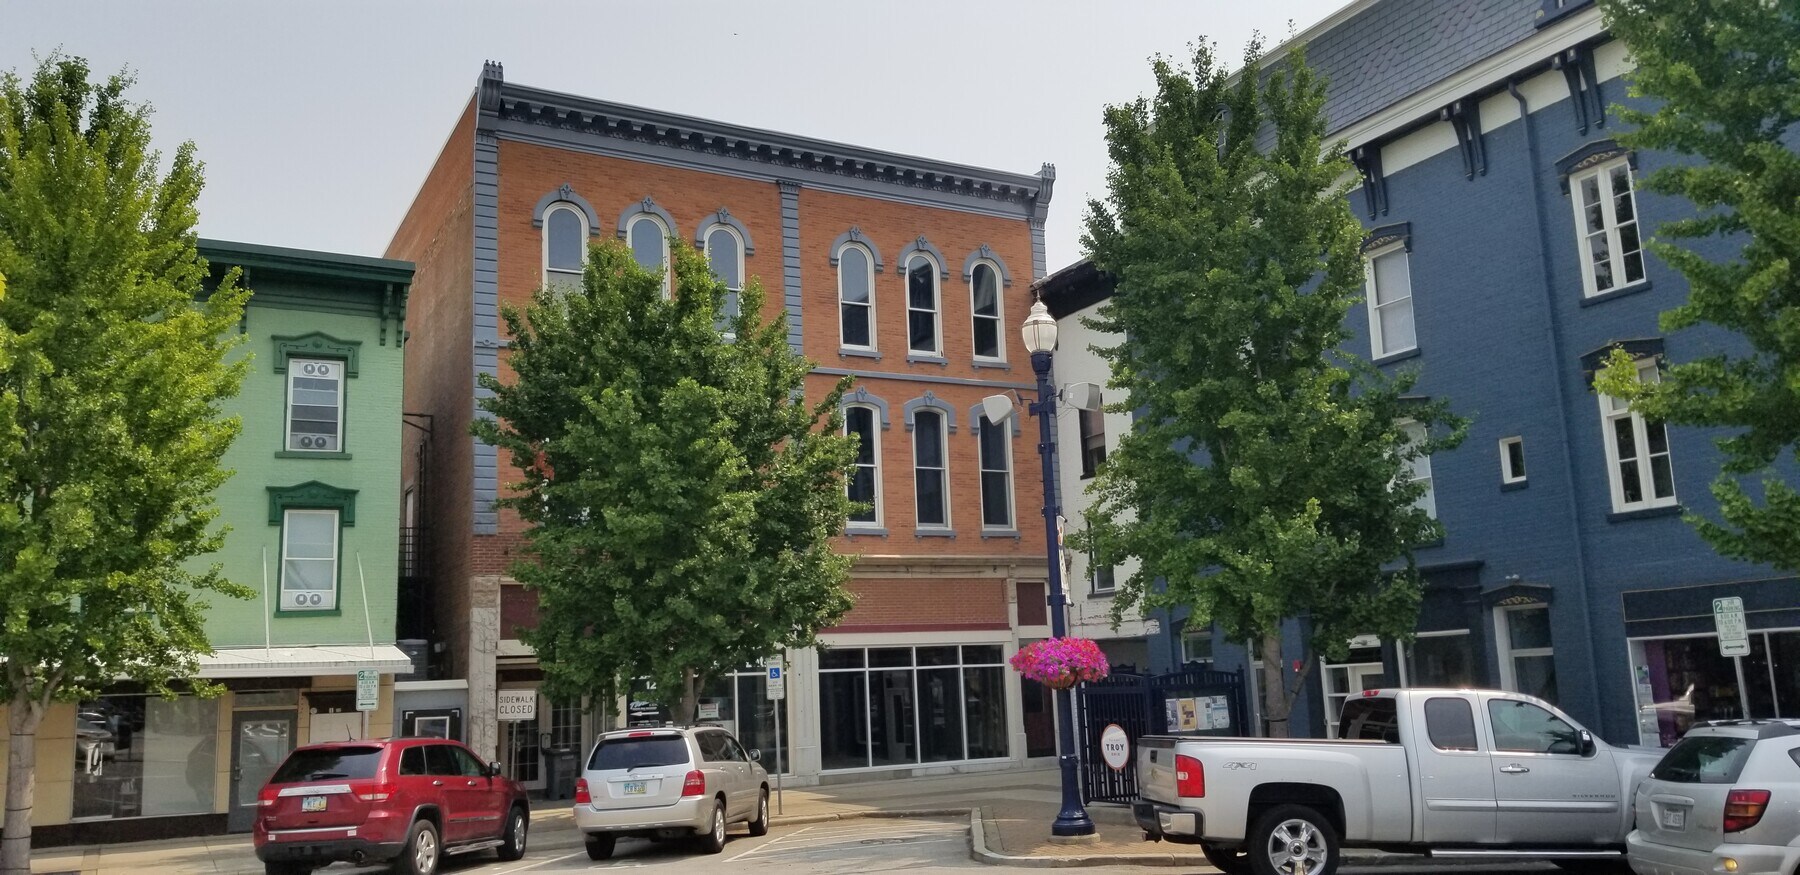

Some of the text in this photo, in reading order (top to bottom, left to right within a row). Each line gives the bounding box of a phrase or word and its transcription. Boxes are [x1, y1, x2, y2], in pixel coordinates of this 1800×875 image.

[1715, 601, 1723, 612] 2
[359, 671, 364, 680] 2
[499, 696, 534, 704] SIDEWALK
[499, 705, 533, 714] CLOSED
[1106, 743, 1124, 751] TROY
